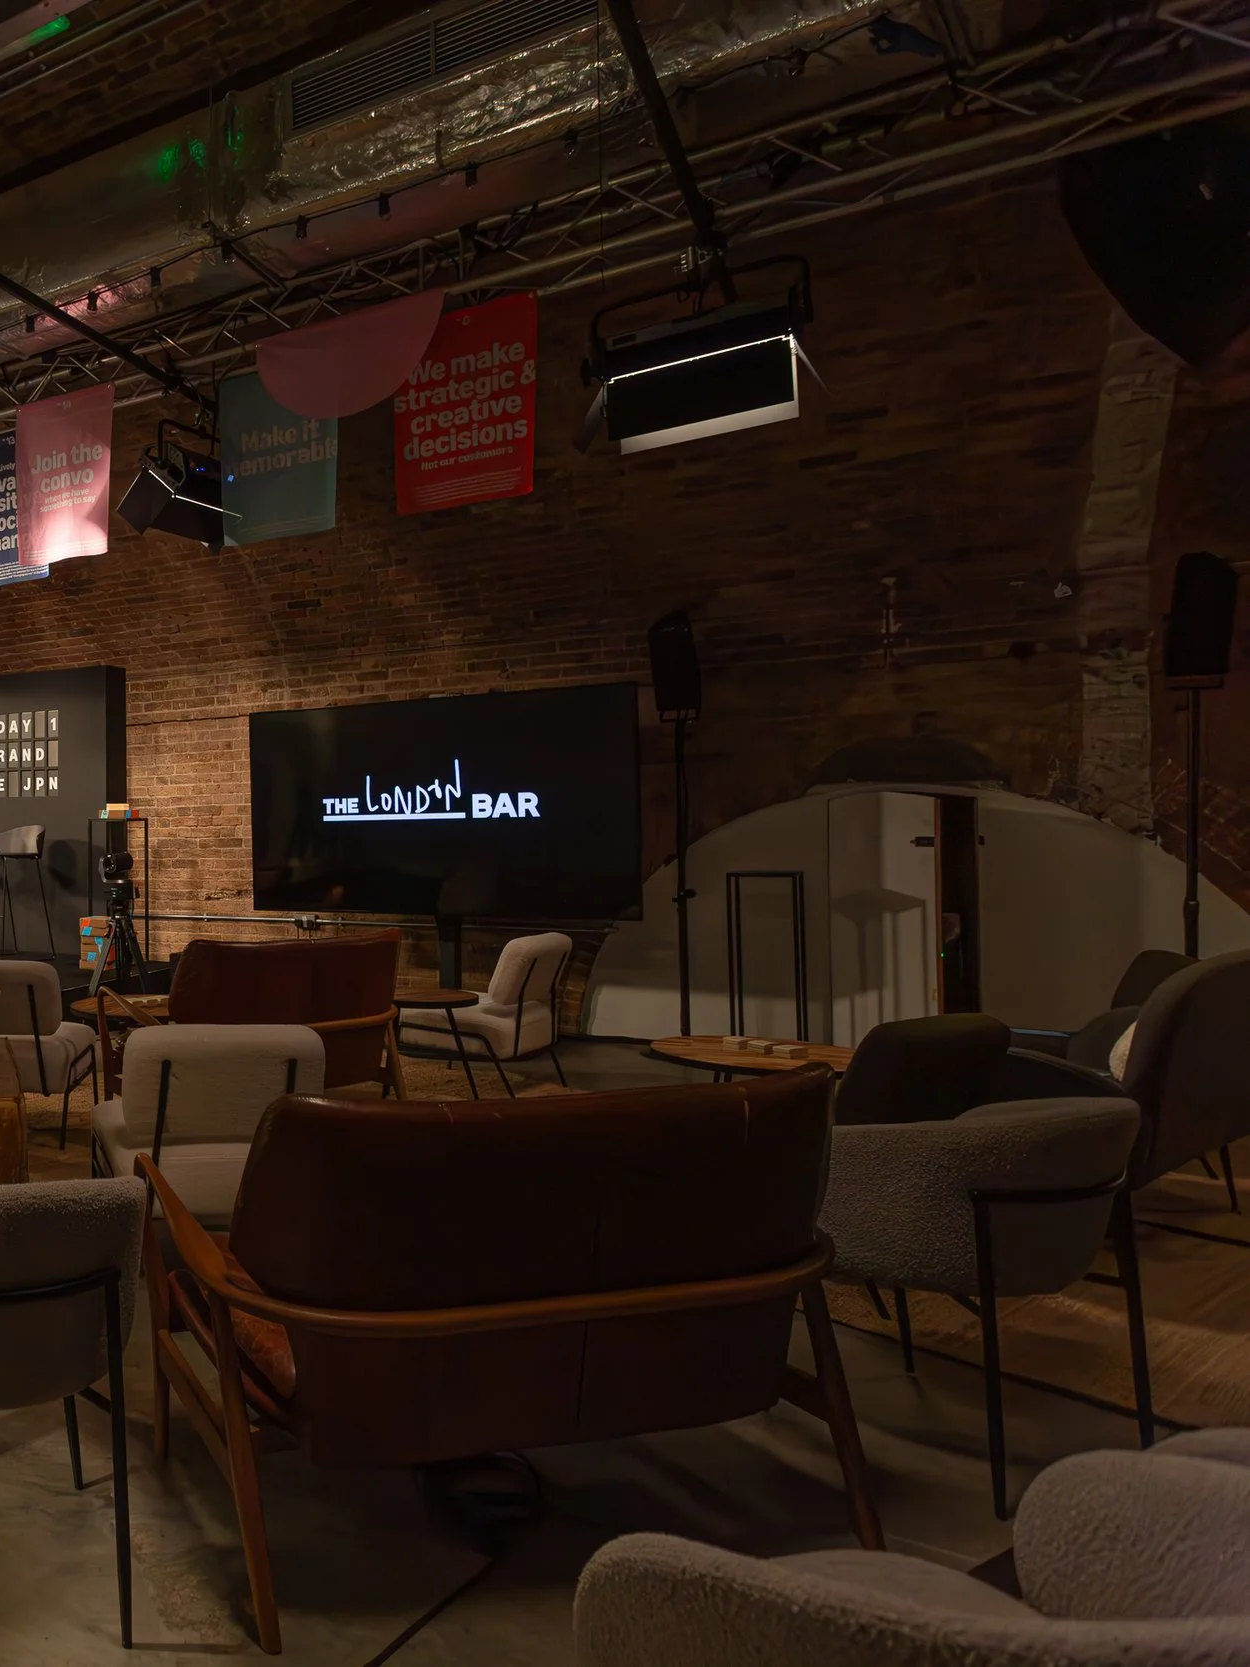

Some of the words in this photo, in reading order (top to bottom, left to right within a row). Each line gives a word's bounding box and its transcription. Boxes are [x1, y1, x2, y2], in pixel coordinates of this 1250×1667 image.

[408, 360, 446, 386] We
[450, 342, 526, 376] make
[393, 367, 515, 413] strategic
[519, 359, 538, 385] &
[410, 394, 523, 435] creative
[240, 424, 298, 453] Make
[302, 419, 319, 443] it
[403, 419, 529, 461] decisions
[30, 450, 67, 475] Join
[70, 443, 103, 465] the
[40, 467, 94, 493] convo
[50, 717, 57, 731] 1
[23, 776, 58, 791] JPN
[322, 797, 360, 815] THE
[366, 759, 462, 815] LONDON
[471, 792, 541, 819] BAR
